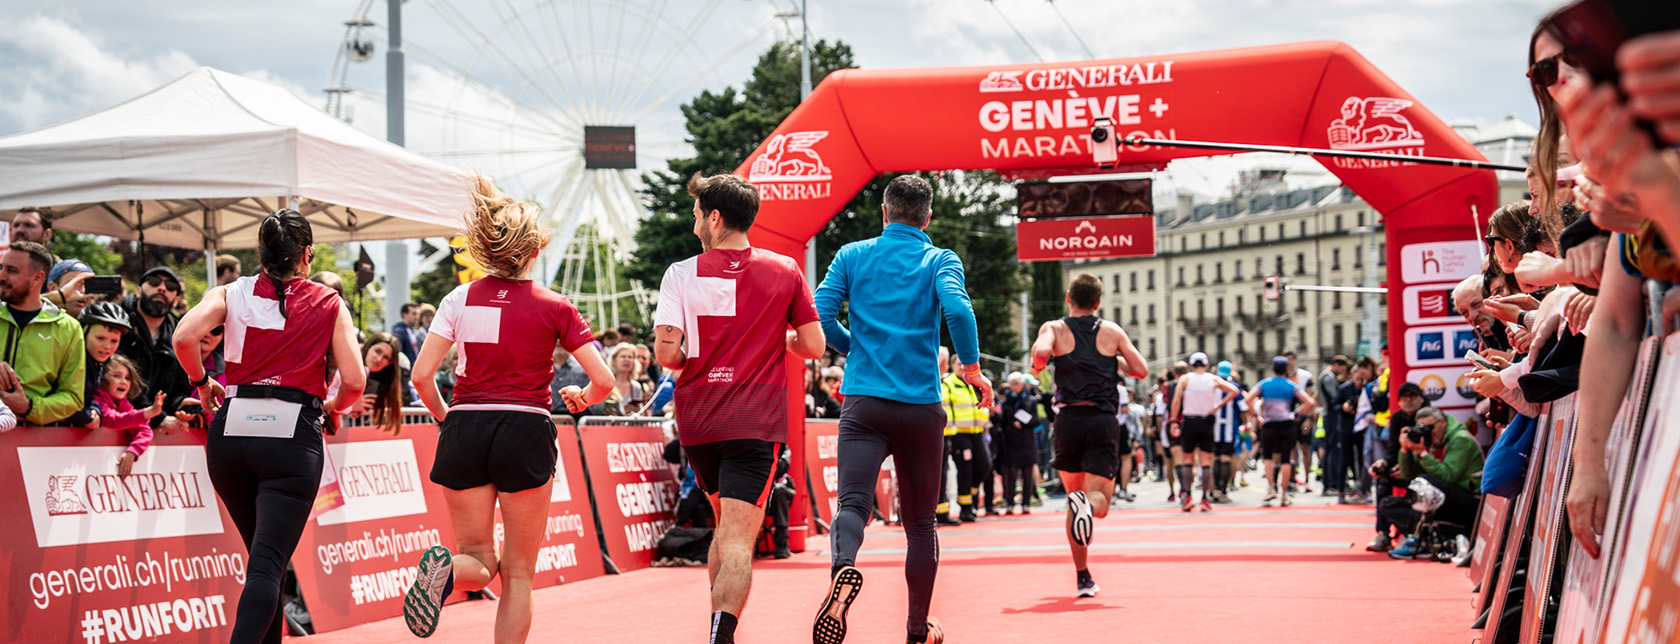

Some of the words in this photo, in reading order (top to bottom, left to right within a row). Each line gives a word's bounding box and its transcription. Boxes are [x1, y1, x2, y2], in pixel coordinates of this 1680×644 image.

[1025, 60, 1175, 91] GENERALI
[978, 90, 1142, 132] GENÈVE
[979, 127, 1177, 158] MARATON
[755, 182, 831, 200] ENERALI
[1039, 234, 1133, 250] NORQAIN
[1421, 339, 1441, 352] P&G
[85, 471, 206, 514] GENERALI
[339, 461, 414, 498] GENERALI
[616, 472, 671, 518] GENÈVE
[29, 548, 247, 610] generali.ch/running
[81, 594, 227, 644] #RUNFORIT
